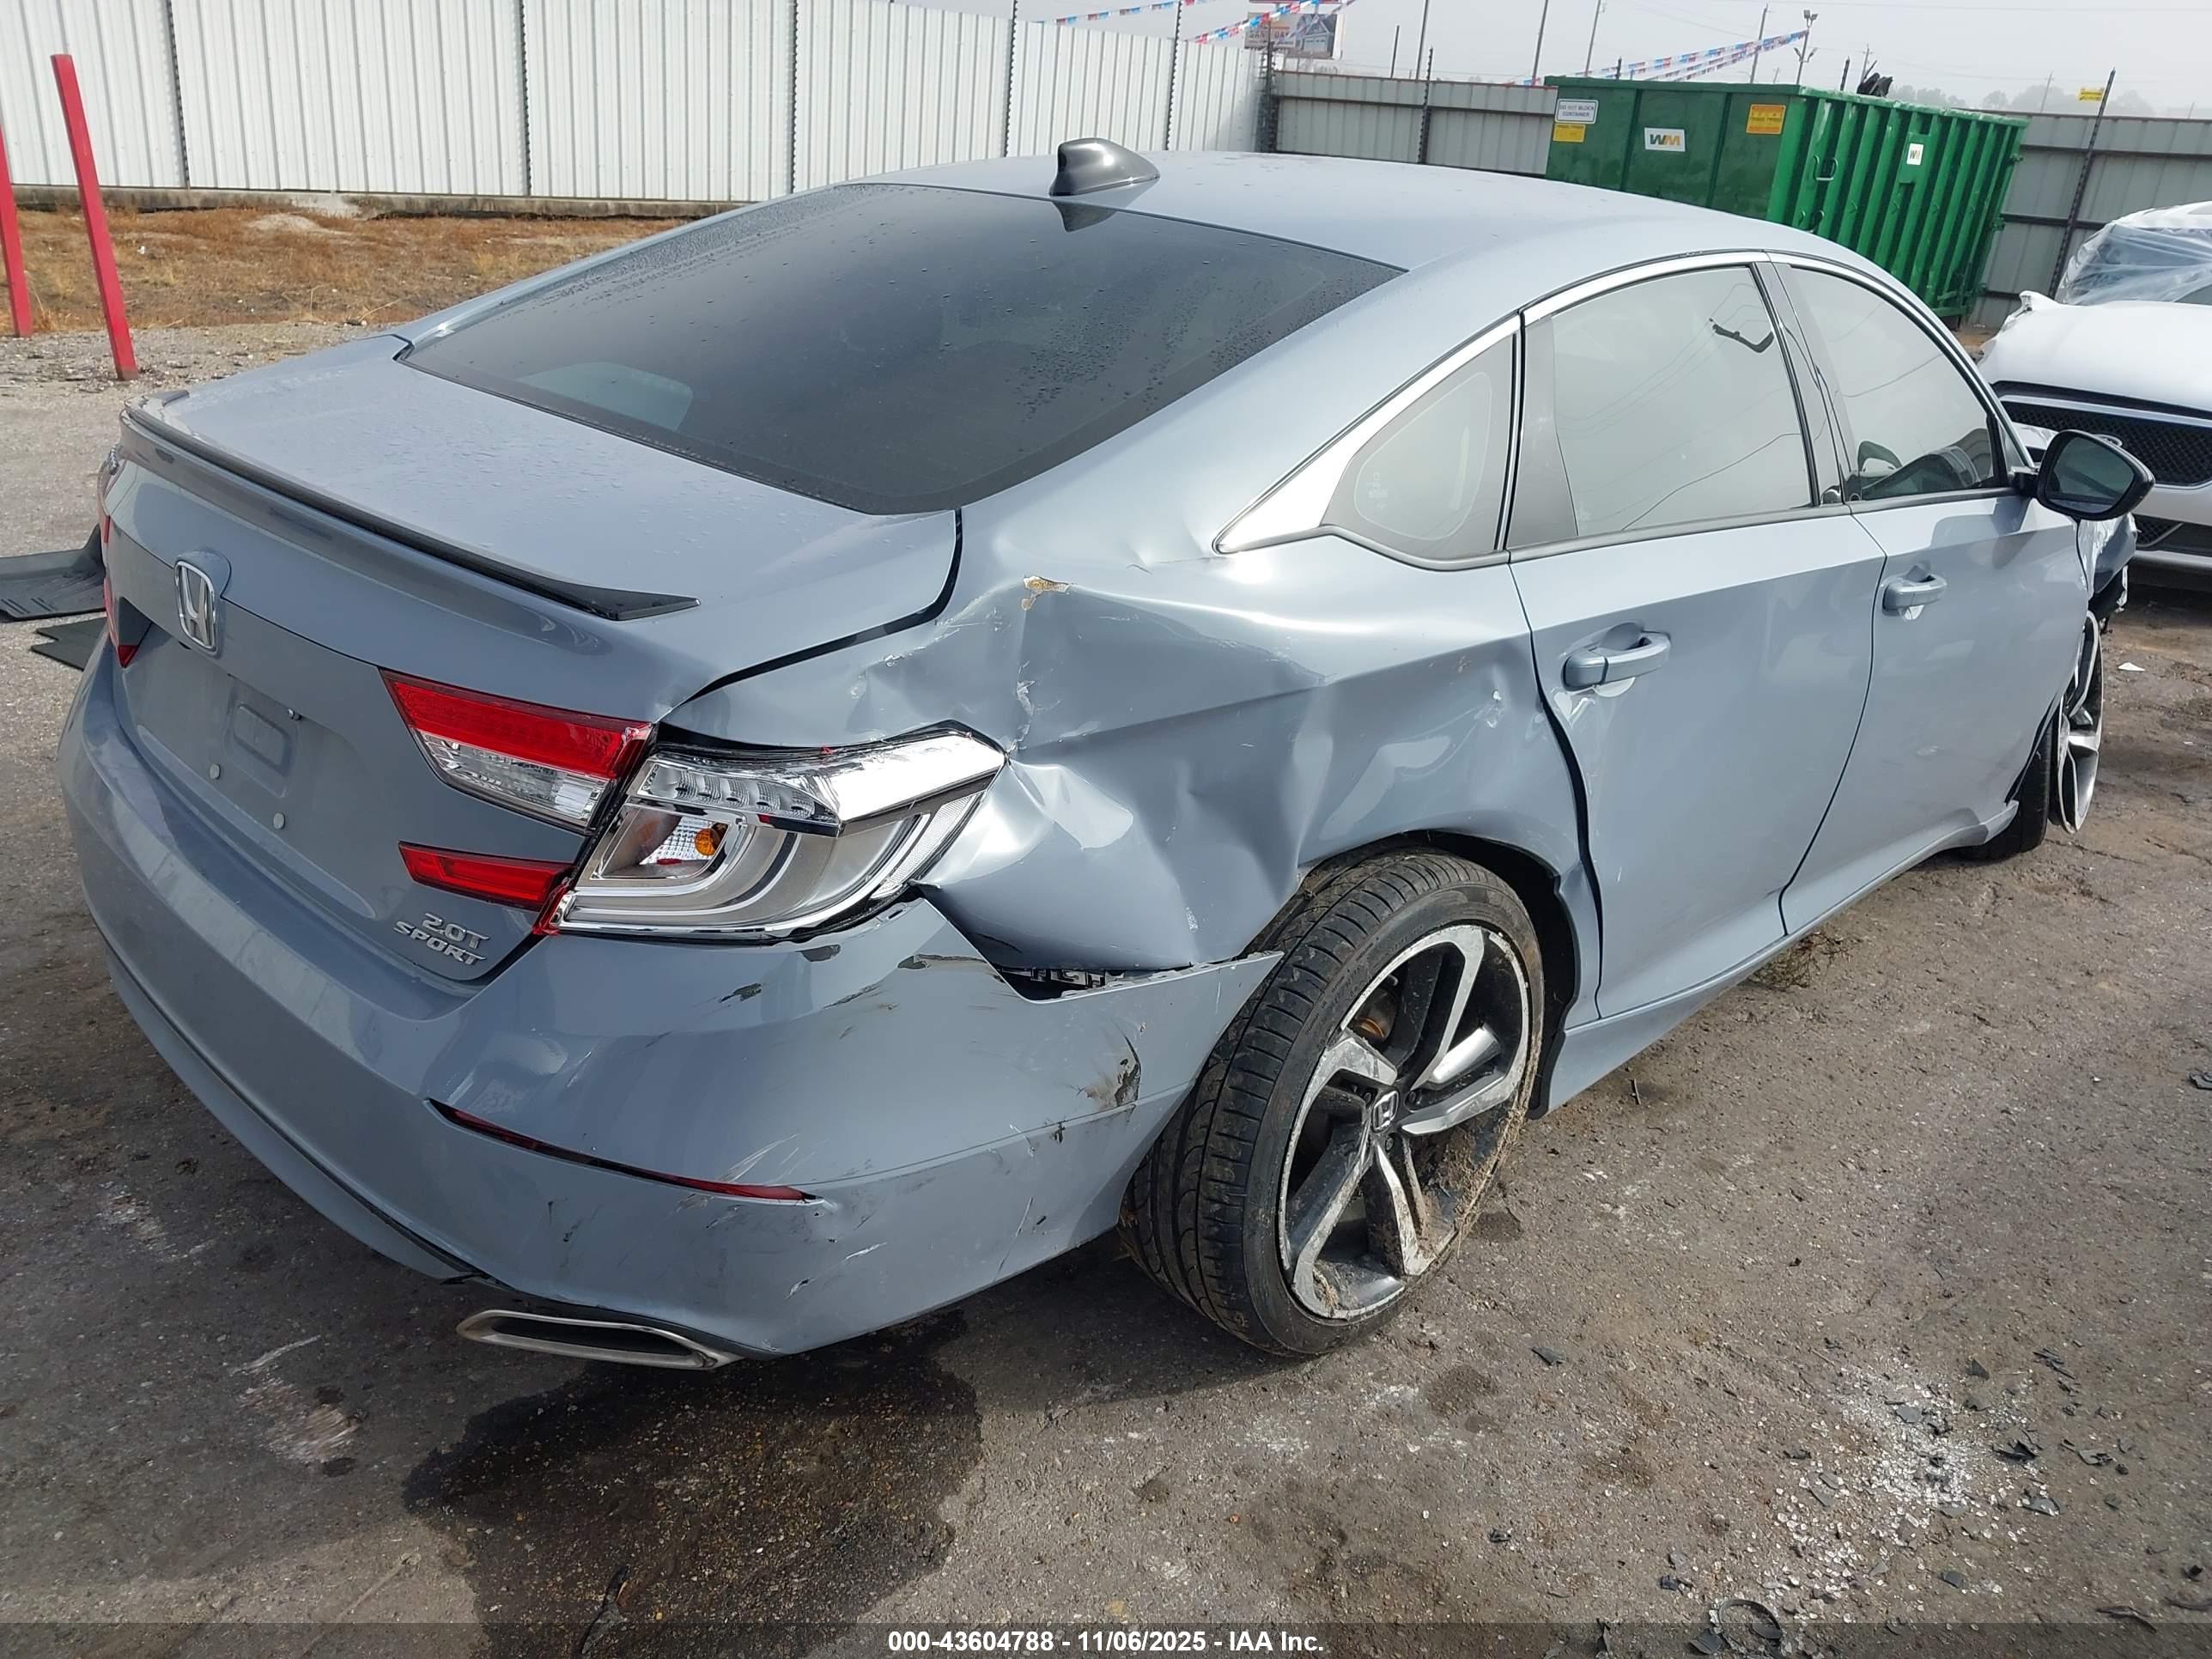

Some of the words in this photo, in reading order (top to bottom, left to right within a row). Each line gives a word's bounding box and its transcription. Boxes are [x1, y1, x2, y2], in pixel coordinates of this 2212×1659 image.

[1650, 134, 1680, 146] WM
[392, 921, 486, 965] SPORT
[422, 912, 490, 949] 2.0T
